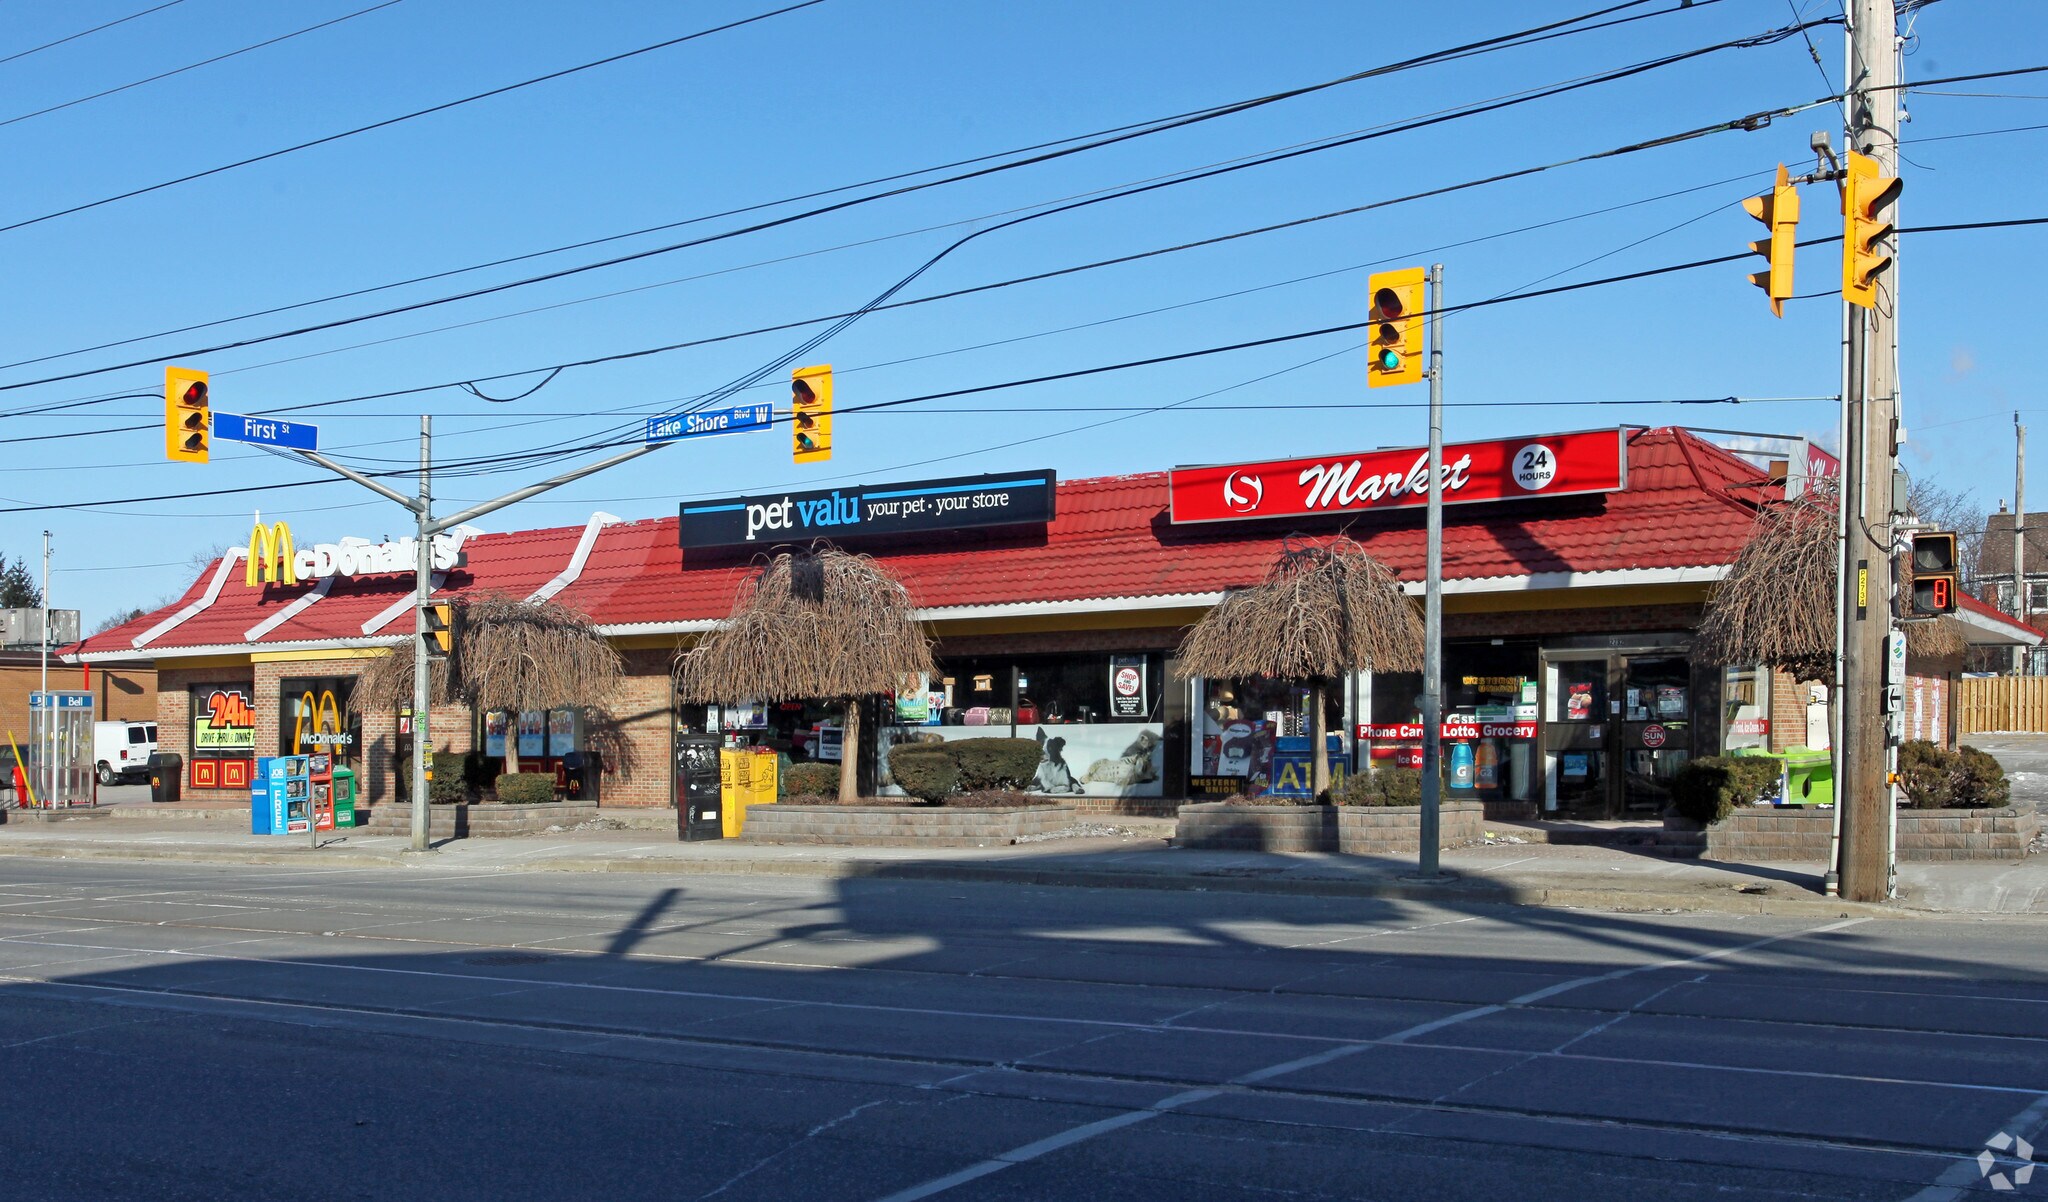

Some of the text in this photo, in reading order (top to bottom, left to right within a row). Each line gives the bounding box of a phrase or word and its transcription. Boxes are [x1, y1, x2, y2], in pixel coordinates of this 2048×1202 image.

[649, 406, 768, 437] Lake Shore Blvd W
[244, 418, 290, 440] First St
[1522, 451, 1548, 470] 24
[1298, 450, 1471, 509] Market
[1519, 471, 1551, 482] HOURS
[745, 490, 1009, 540] pet valu your pet your store
[1859, 569, 1867, 606] P2734
[1934, 579, 1947, 609] 8
[1120, 671, 1137, 681] SHOP
[1117, 681, 1135, 692] SAVE!
[68, 696, 83, 706] Bell
[300, 732, 353, 745] McDonald's
[1360, 725, 1535, 739] Phone Car Lotto, Grocery
[1644, 732, 1663, 740] SUN
[1397, 755, 1410, 764] Ice
[271, 768, 284, 776] JOB
[1277, 762, 1345, 790] ATM
[1479, 768, 1493, 777] G2
[1191, 778, 1237, 786] WESTERN
[274, 789, 283, 829] FREE
